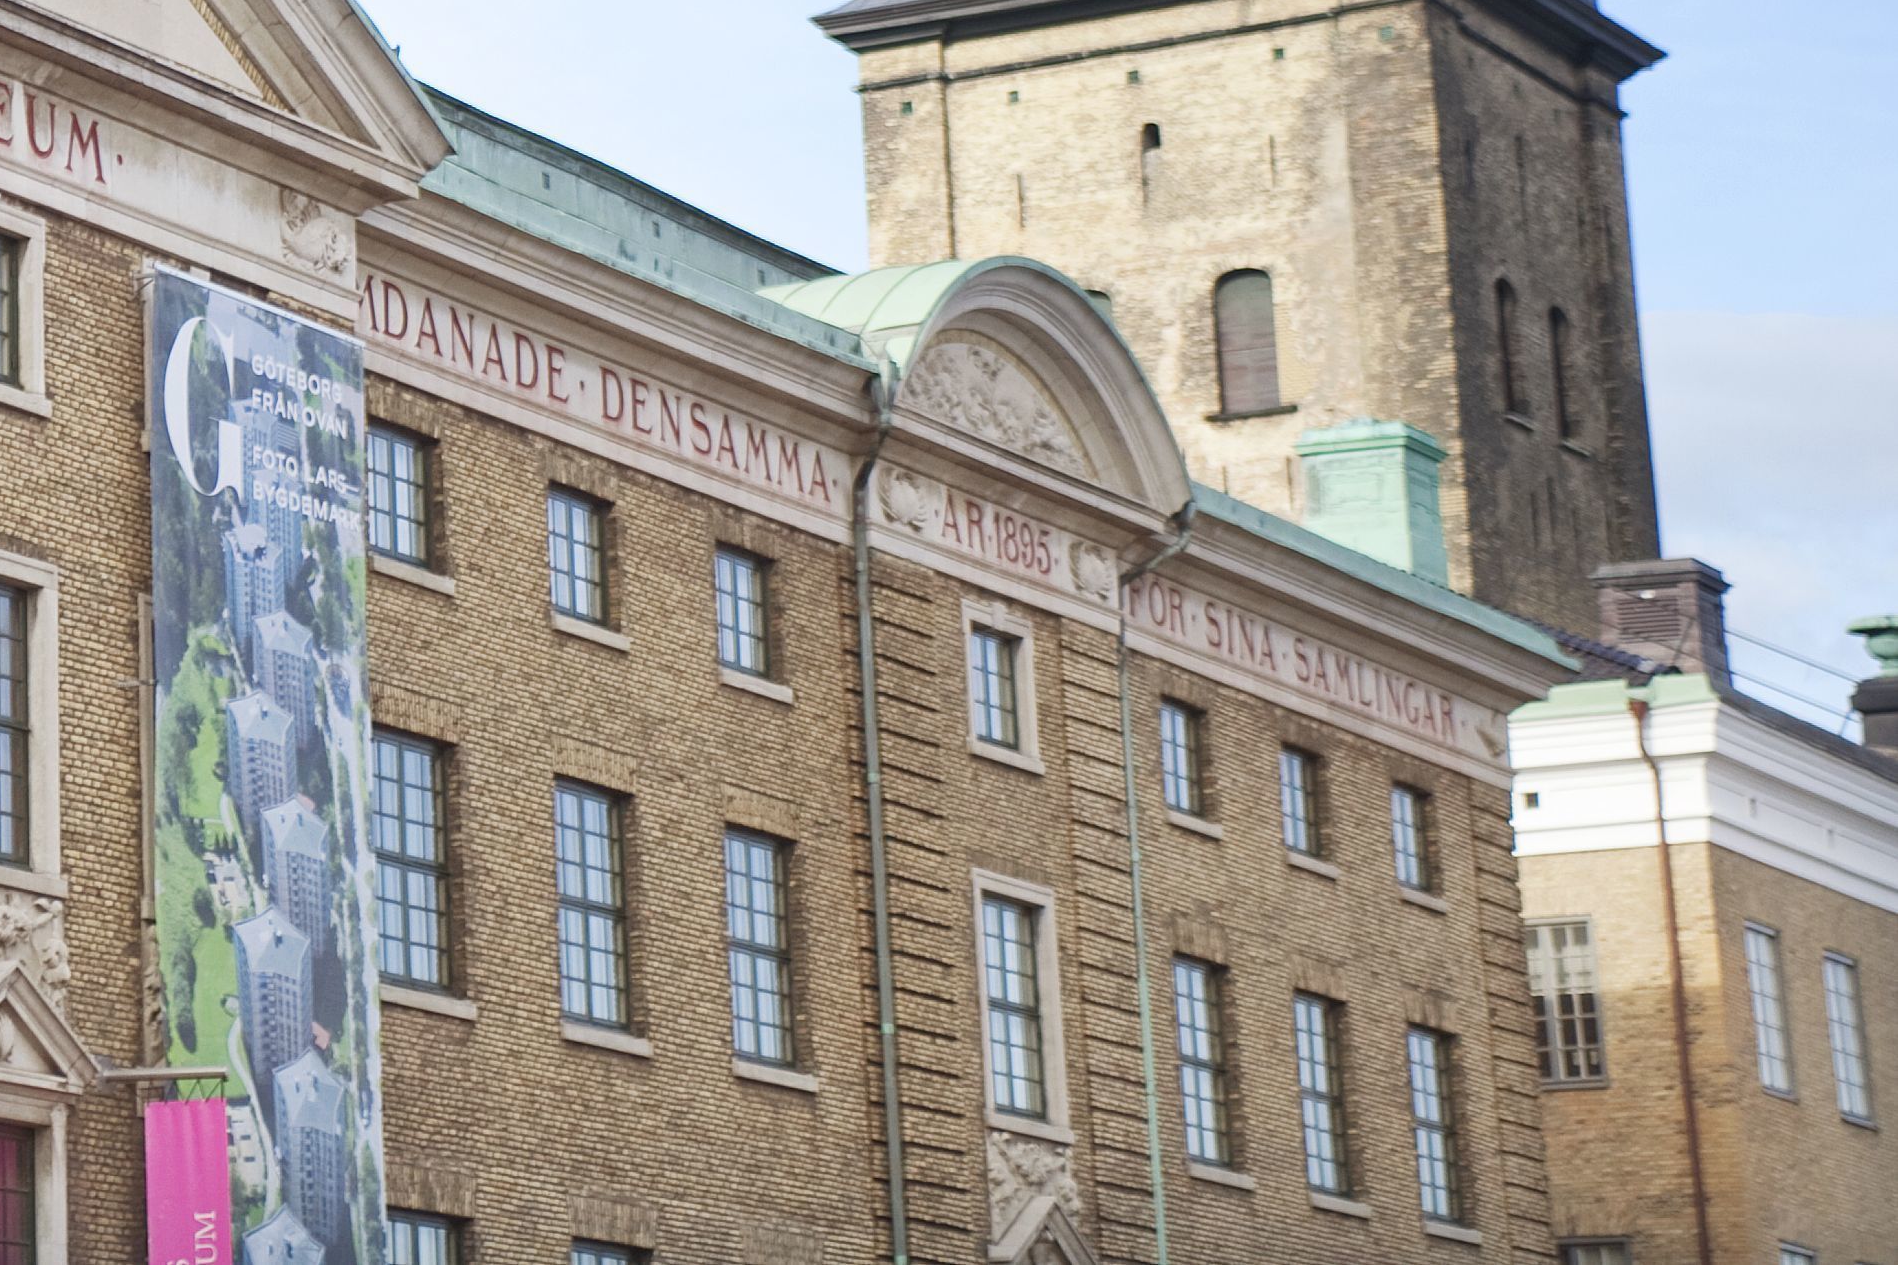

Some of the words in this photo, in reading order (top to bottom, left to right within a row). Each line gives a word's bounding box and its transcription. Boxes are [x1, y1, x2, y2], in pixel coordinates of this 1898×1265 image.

[251, 354, 342, 404] GÖTEBORG
[252, 388, 298, 423] FRÅN
[302, 406, 348, 440] OVAN
[599, 366, 831, 502] DENSAMMA
[253, 445, 298, 478] FOTO
[305, 463, 346, 494] LARS
[253, 480, 360, 532] BYGDEMARK
[994, 512, 1051, 574] 1895
[1205, 601, 1276, 671] SINA
[1294, 638, 1456, 742] SAMLINGAR
